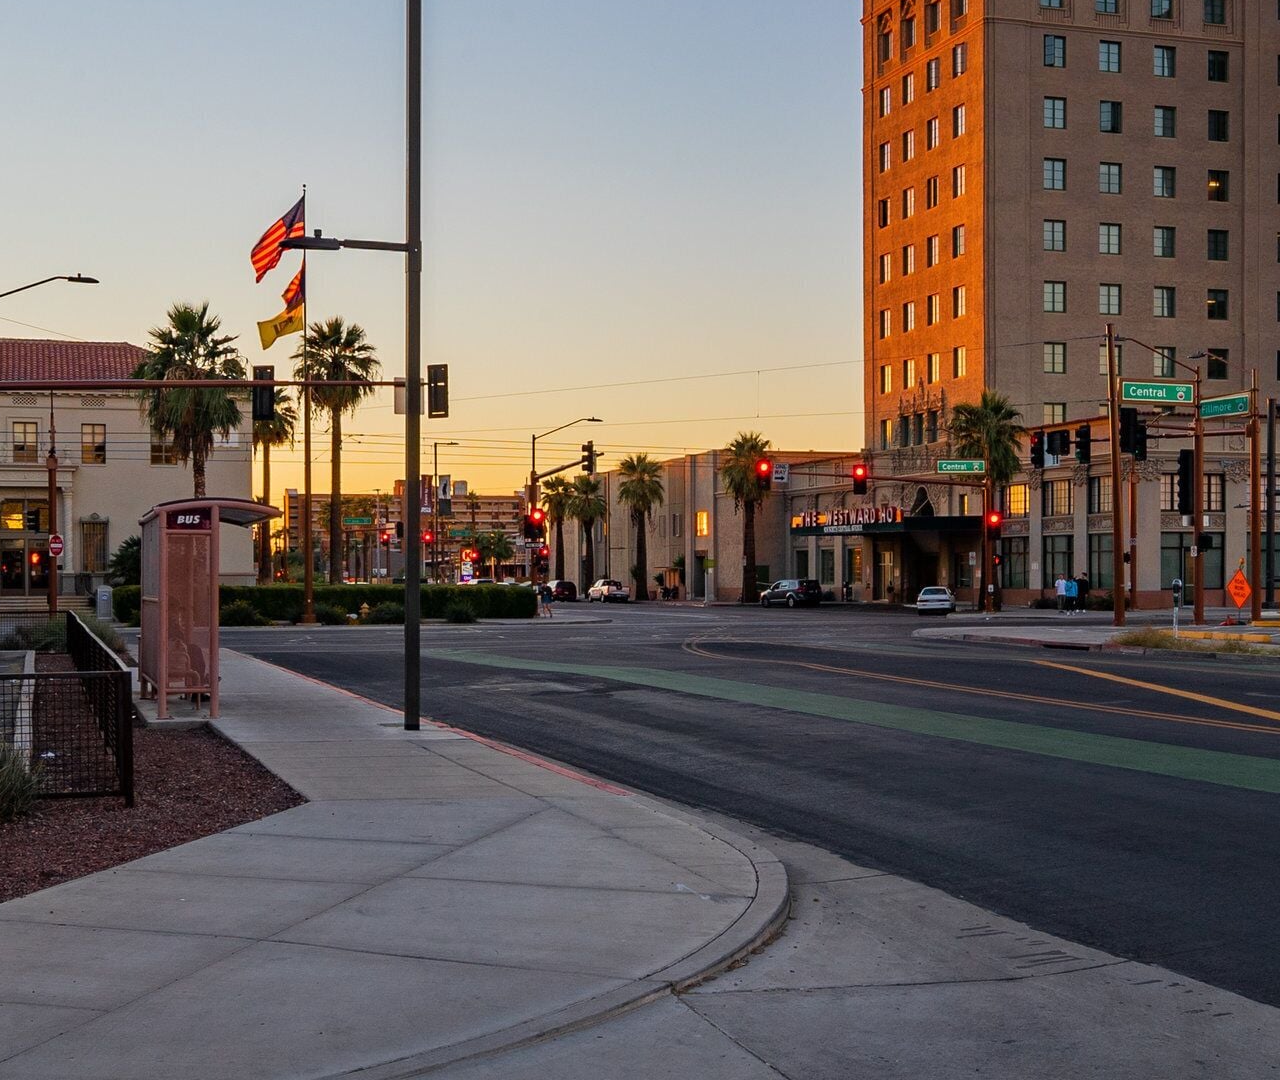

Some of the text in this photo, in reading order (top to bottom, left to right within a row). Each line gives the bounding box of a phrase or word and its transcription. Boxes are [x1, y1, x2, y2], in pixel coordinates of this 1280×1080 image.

[1130, 386, 1166, 398] Central
[1202, 404, 1232, 414] Fillmore
[176, 514, 200, 524] BUS
[800, 508, 893, 527] THE WESTWARD HO
